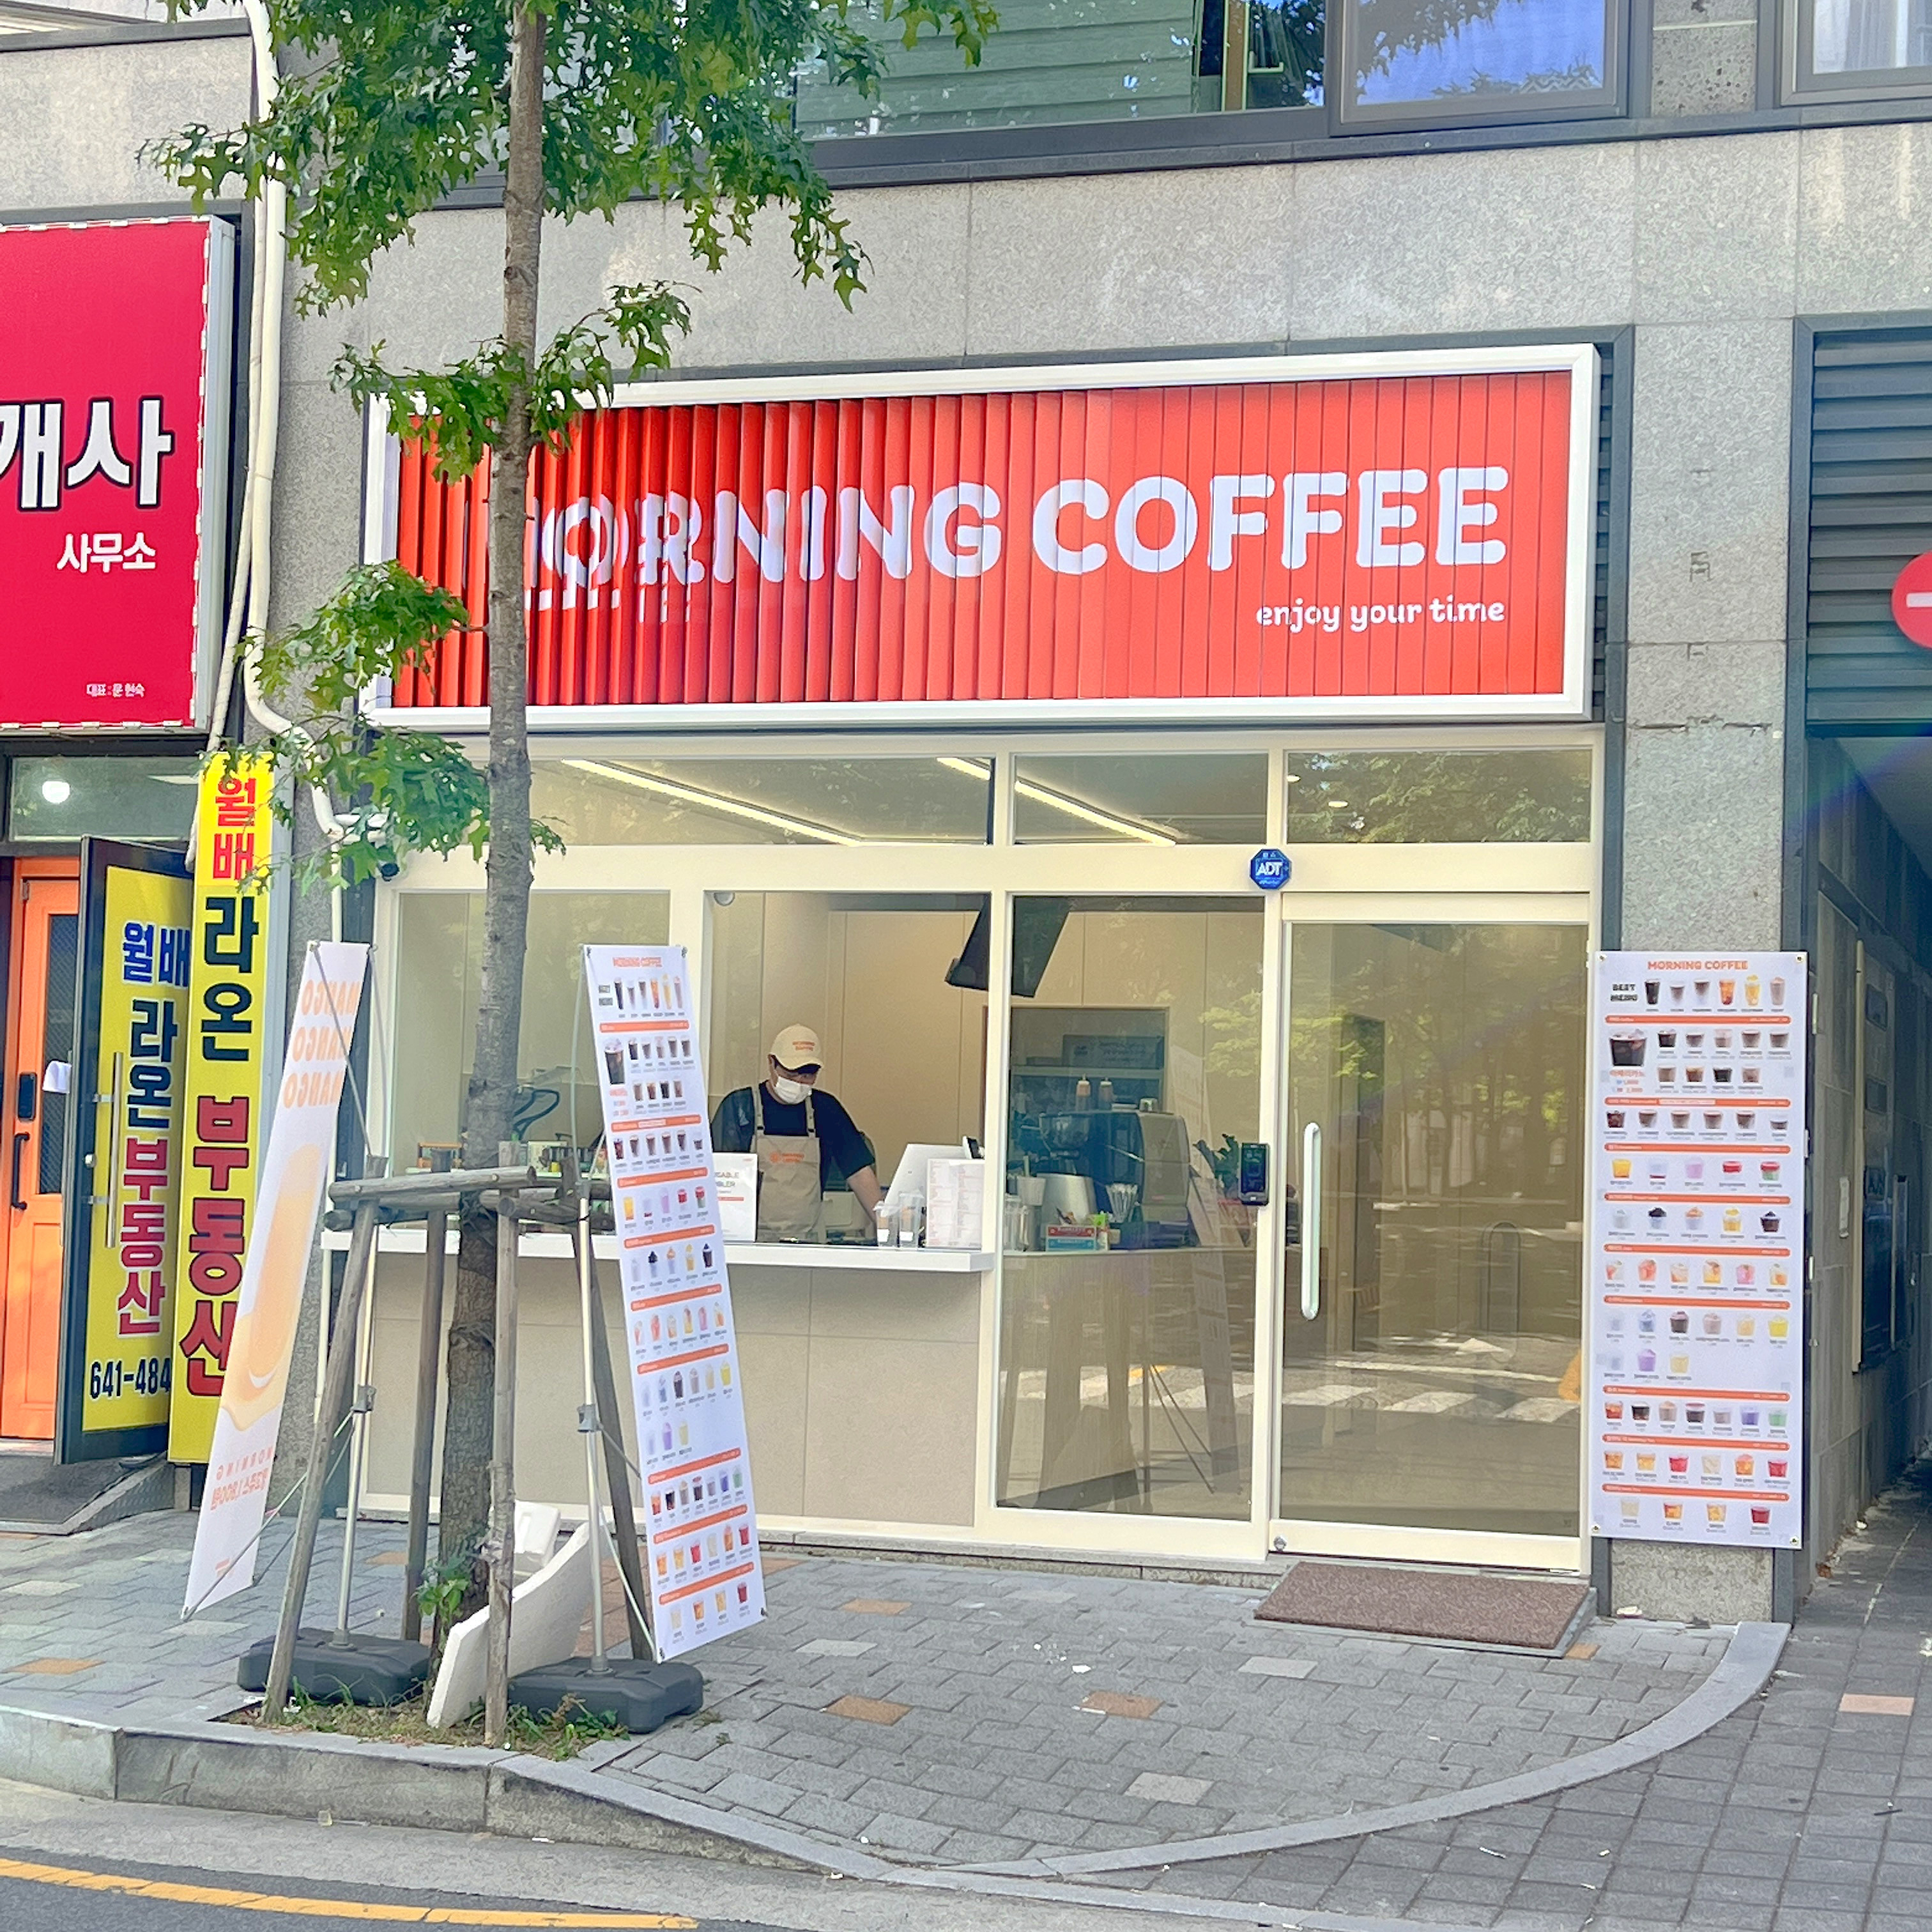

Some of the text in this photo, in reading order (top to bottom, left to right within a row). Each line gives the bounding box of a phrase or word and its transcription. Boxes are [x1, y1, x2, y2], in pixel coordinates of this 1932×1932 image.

[463, 466, 1508, 580] ORNING COFFEE
[57, 533, 156, 573] 사무소
[1256, 594, 1505, 633] enjoy your time
[1255, 861, 1283, 876] ADT
[123, 922, 191, 987] 월배
[1648, 960, 1749, 970] MORNING COFFEE
[180, 778, 259, 1397] 월배 라온 부동산
[118, 999, 178, 1335] 라온 부동산
